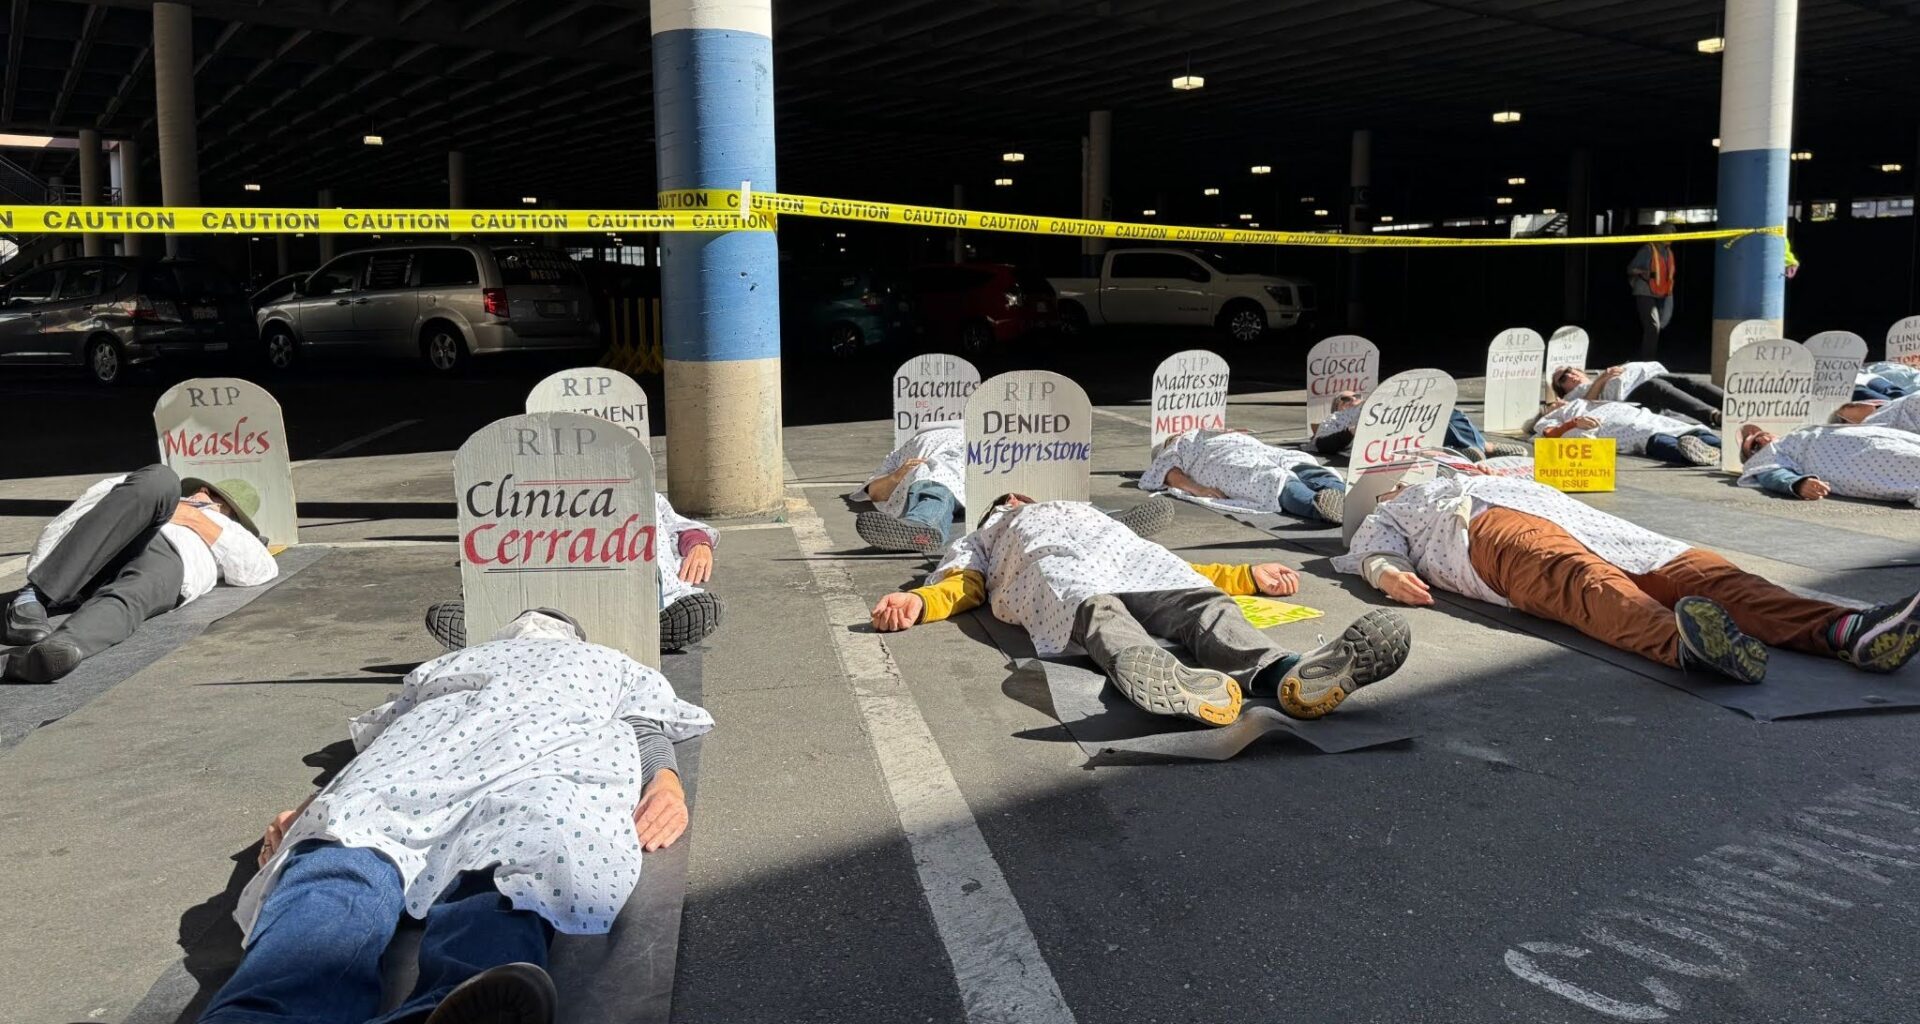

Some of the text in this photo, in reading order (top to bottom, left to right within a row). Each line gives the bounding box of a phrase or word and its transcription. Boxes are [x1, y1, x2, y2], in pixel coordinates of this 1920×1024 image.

[43, 211, 767, 230] CAUTION CAUTION CAUTION CAUTION CAUTION CAUTION
[727, 193, 804, 212] CUTION
[820, 200, 890, 220] CAUTION
[903, 208, 967, 226] CAUTION
[979, 218, 1039, 231] CAUTION
[1050, 221, 1105, 236] CAUTION
[1115, 225, 1168, 239] CAUTION
[1176, 229, 1225, 241] CAUTION
[1233, 232, 1280, 243] CAUTION
[1286, 234, 1329, 244] CAUTION
[1904, 319, 1920, 329] RI
[1329, 341, 1359, 354] RIP
[1506, 333, 1530, 346] RIP
[1823, 336, 1852, 349] RIP
[1309, 350, 1371, 376] Closed
[1491, 352, 1539, 365] Caregiver
[1755, 345, 1792, 361] RIP
[920, 361, 955, 376] RIP
[1178, 357, 1209, 372] RIP
[1492, 367, 1537, 379] Deported
[1815, 359, 1861, 370] ENCION
[561, 376, 611, 397] RIP
[896, 376, 980, 398] Pacientes
[1003, 381, 1056, 402] RIP
[1155, 370, 1229, 392] Madres sin
[1311, 374, 1369, 395] Clinic
[1392, 377, 1437, 397] RIP
[1726, 370, 1812, 395] Cuidadora
[187, 386, 240, 407] RIP
[1364, 396, 1442, 436] Staffing
[1725, 395, 1810, 424] Deportada
[983, 410, 1070, 435] DENIED
[1155, 414, 1223, 435] MEDICA
[162, 416, 270, 458] Measles
[514, 427, 597, 456] RIP
[967, 436, 1090, 474] Mifepristone
[1558, 443, 1593, 460] ICE
[1538, 468, 1575, 478] PUBLIC
[1576, 468, 1611, 478] HEALTH
[1562, 479, 1589, 488] ISSUE
[466, 473, 617, 518] Clinica
[464, 513, 657, 564] Cerrada
